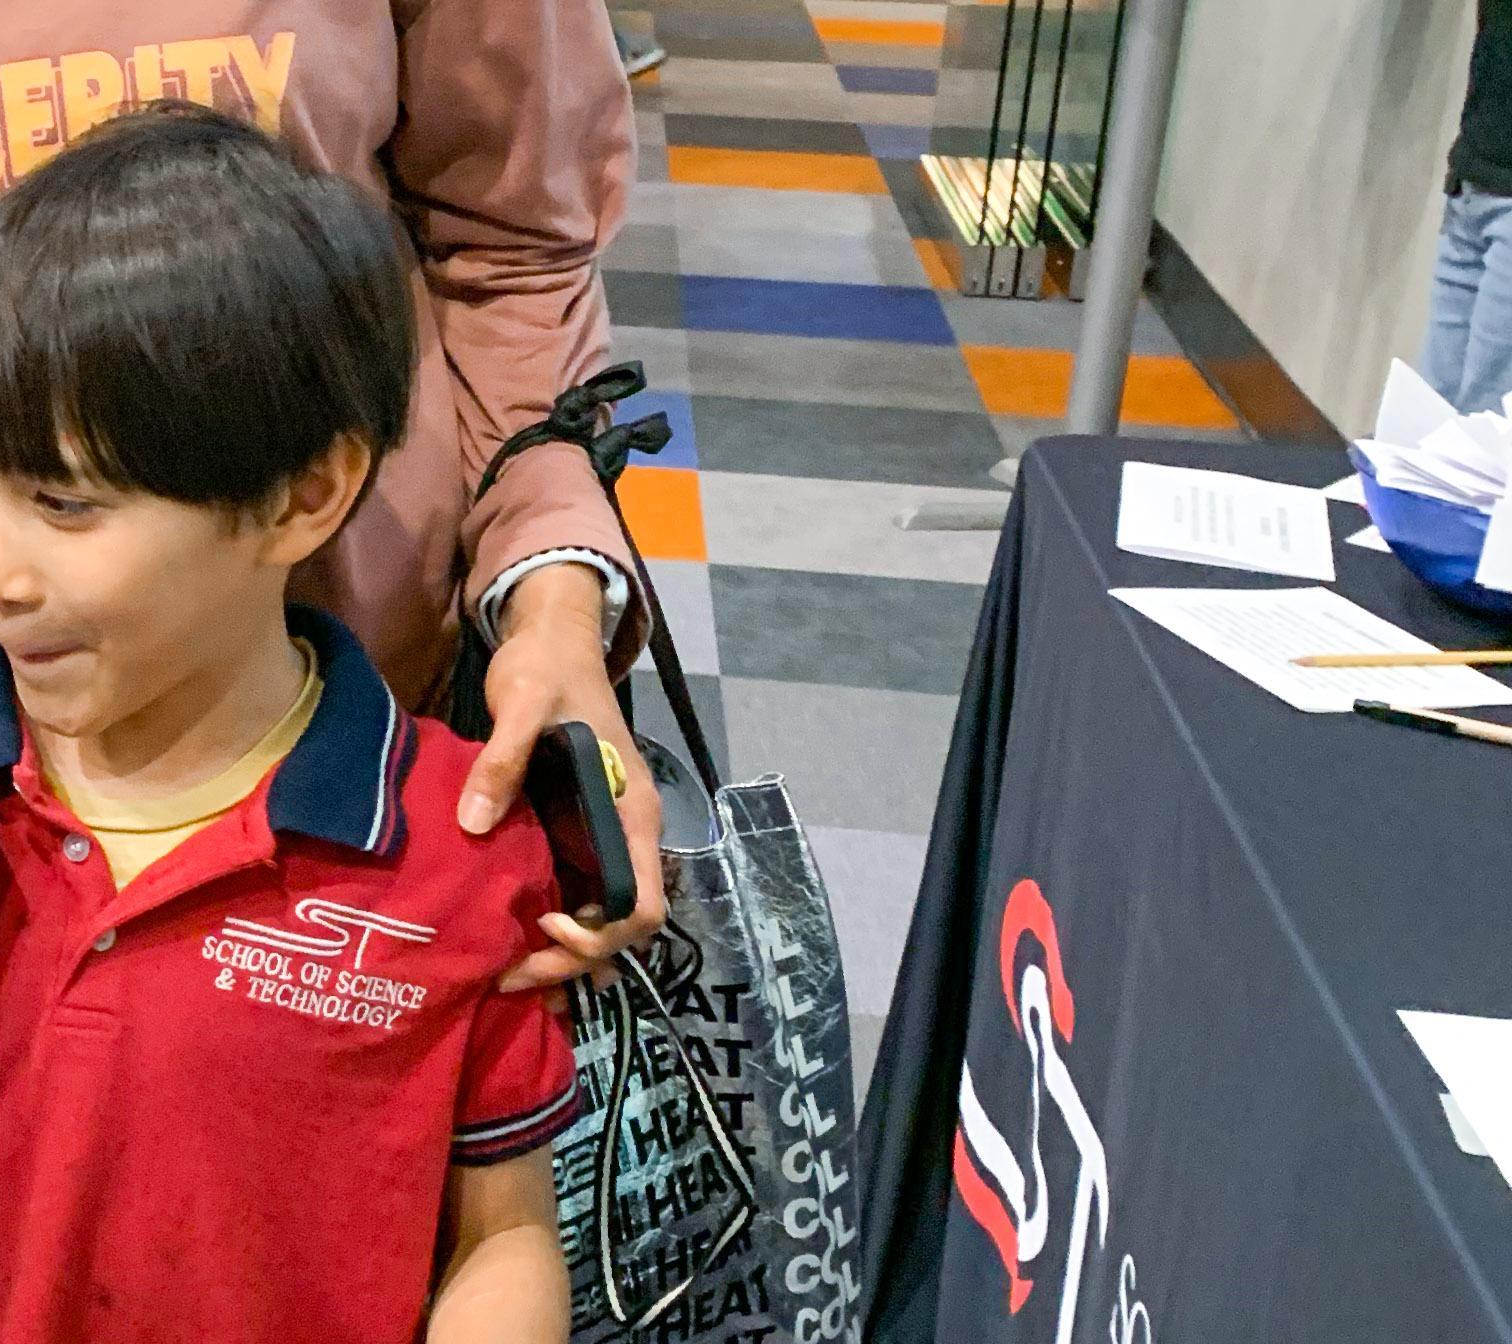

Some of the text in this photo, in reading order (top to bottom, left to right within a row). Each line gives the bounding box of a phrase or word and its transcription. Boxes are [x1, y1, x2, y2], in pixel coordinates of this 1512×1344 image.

[201, 935, 428, 1010] SCHOOL OF SCIENCE
[214, 967, 403, 1030] & TECHNOLOGY
